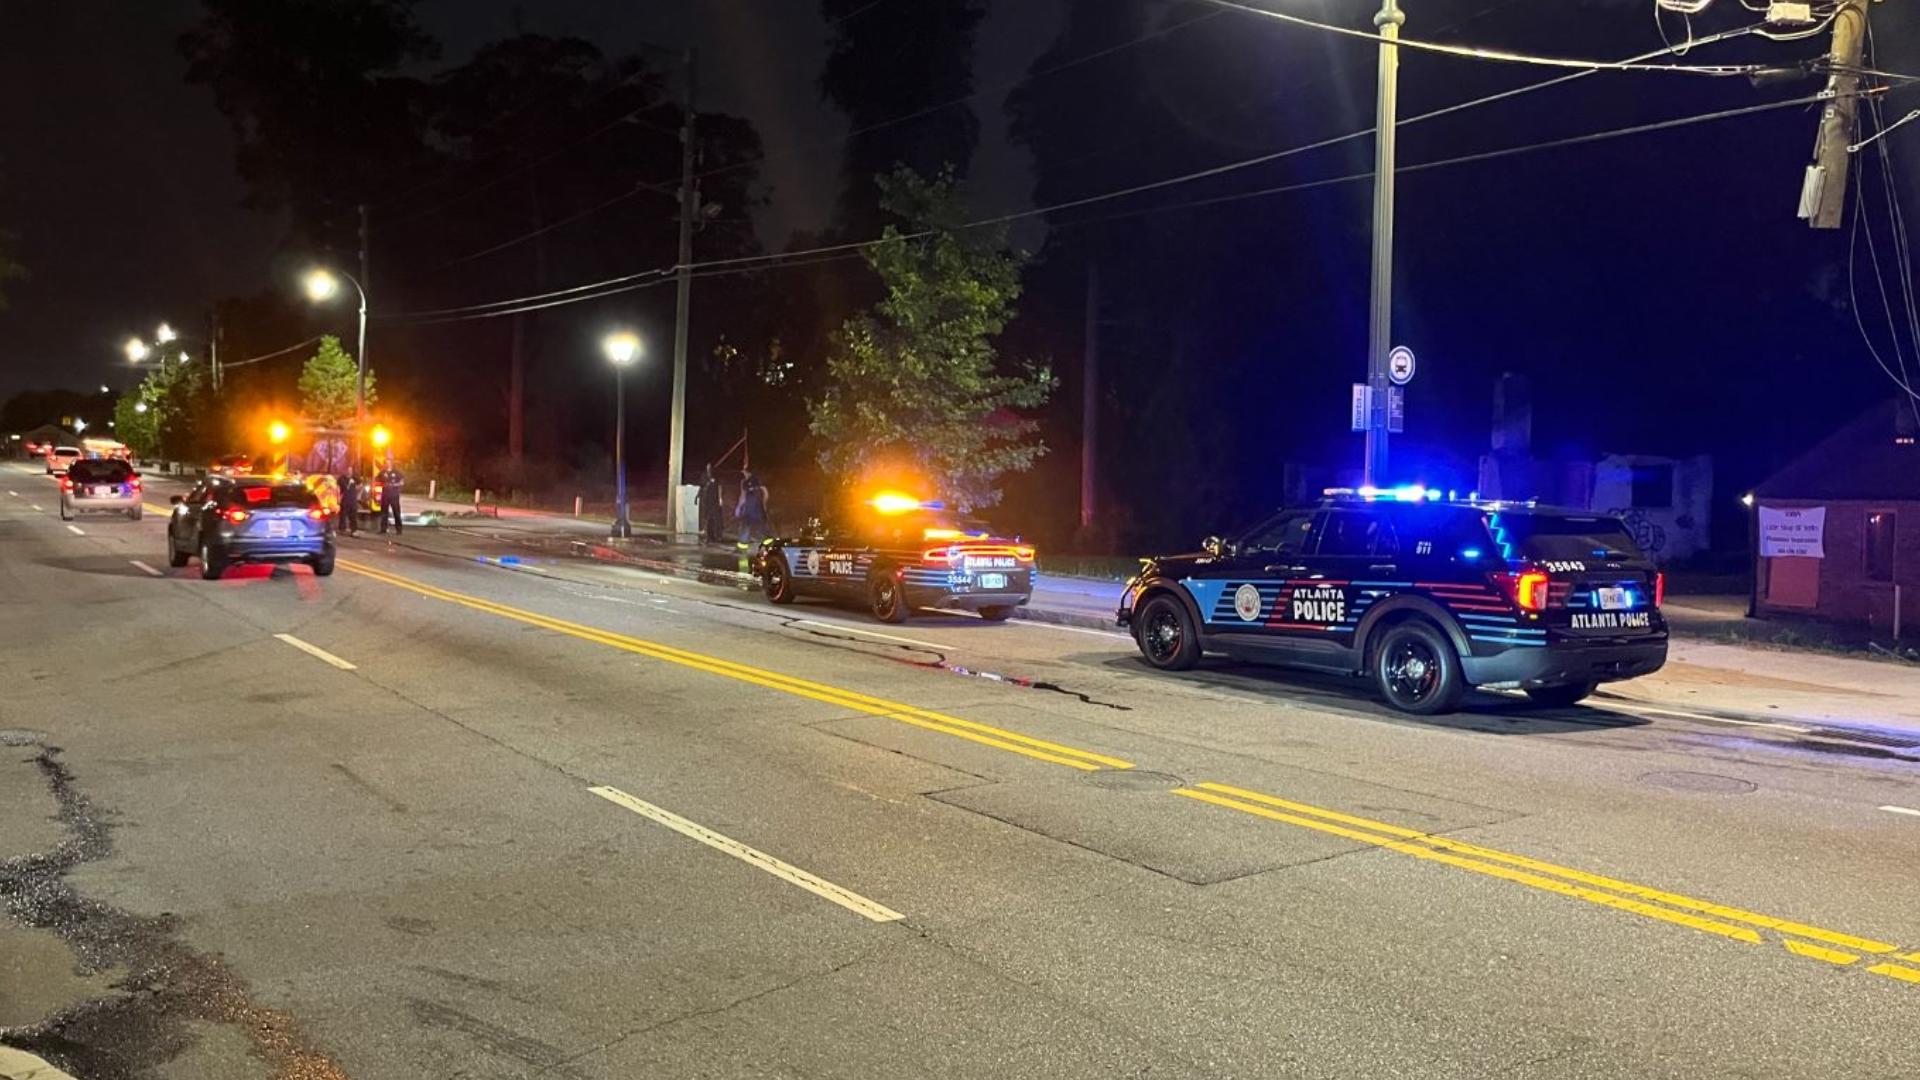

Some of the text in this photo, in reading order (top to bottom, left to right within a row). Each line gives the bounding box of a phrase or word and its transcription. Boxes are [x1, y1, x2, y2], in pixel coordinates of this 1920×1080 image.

[829, 561, 853, 574] POLICE
[993, 557, 1015, 567] POLICE
[1293, 589, 1344, 600] ATLANTA
[1294, 601, 1345, 621] POLICE
[1571, 612, 1650, 628] ATLANTA POLICE
